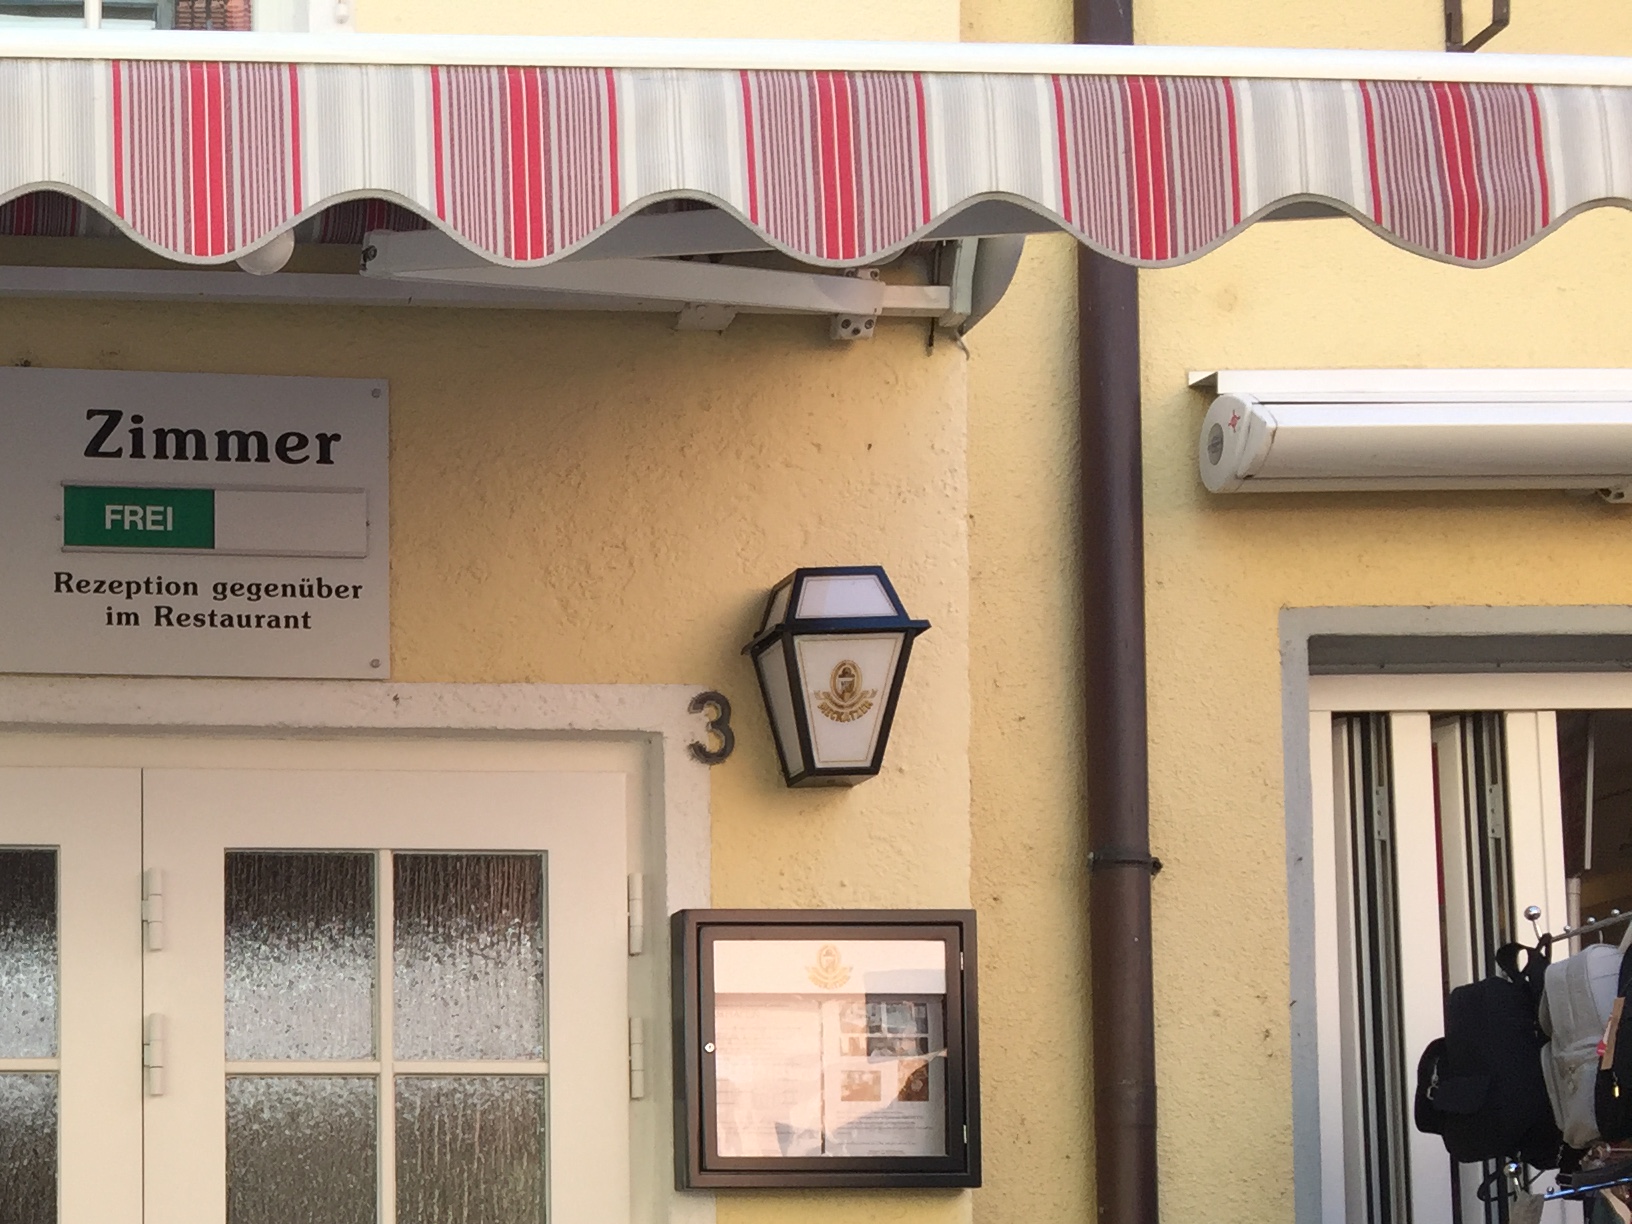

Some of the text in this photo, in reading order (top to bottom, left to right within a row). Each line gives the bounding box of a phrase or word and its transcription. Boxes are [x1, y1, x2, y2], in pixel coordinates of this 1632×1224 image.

[84, 408, 342, 465] Zimmer
[104, 504, 174, 532] FREI
[53, 572, 363, 602] Rezeption gegenüber
[105, 606, 312, 631] im Restaurant
[687, 690, 736, 766] 3
